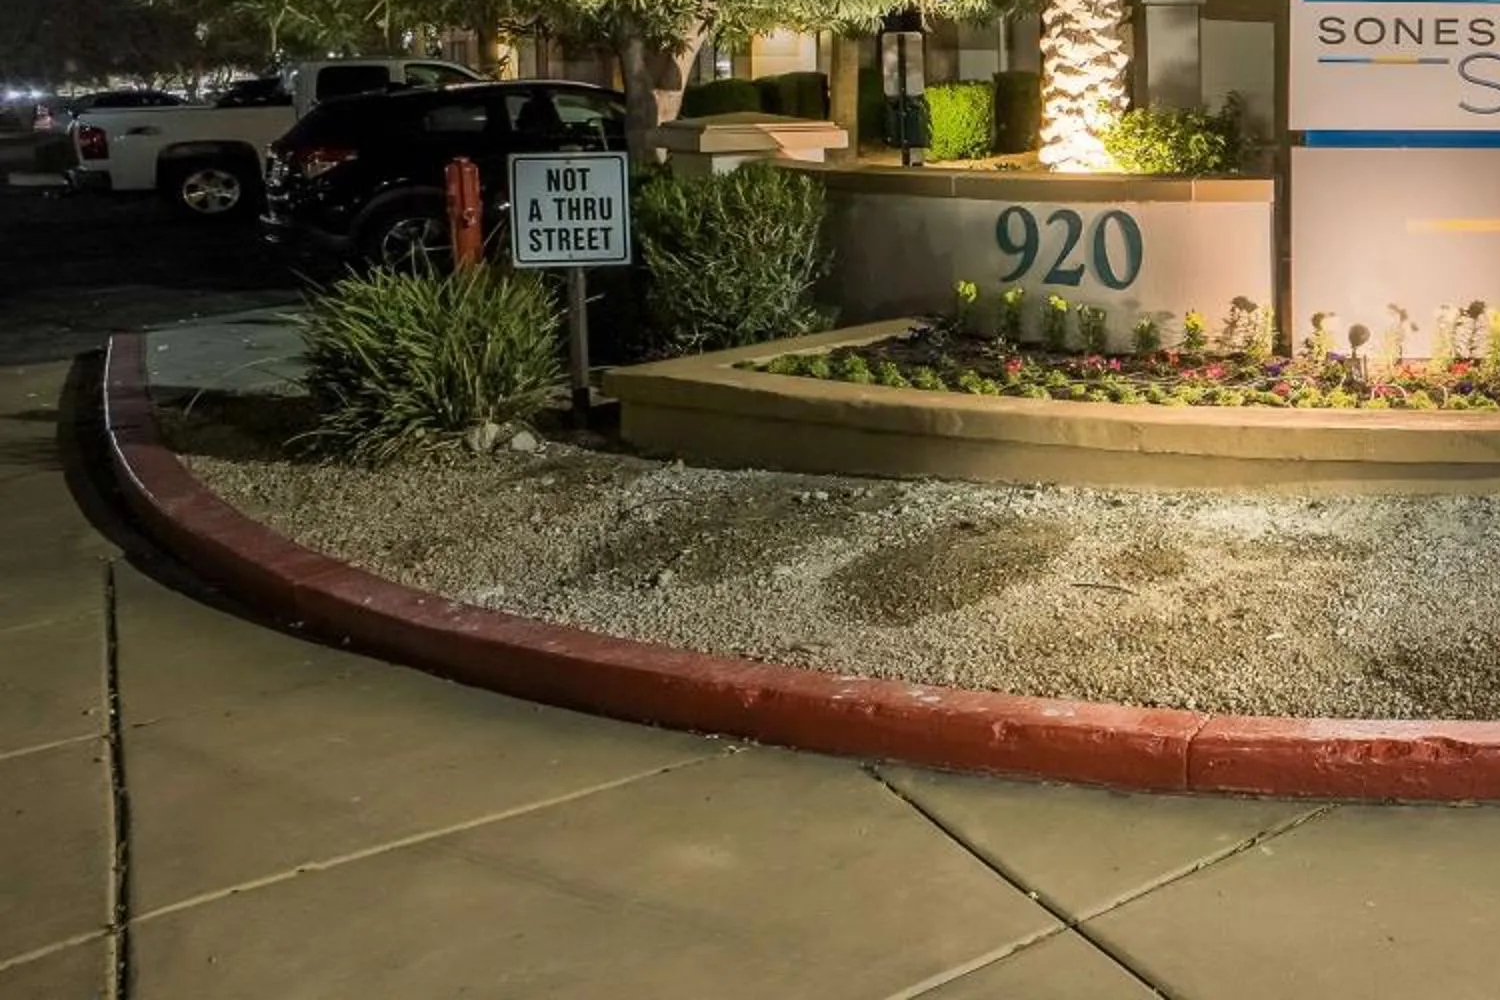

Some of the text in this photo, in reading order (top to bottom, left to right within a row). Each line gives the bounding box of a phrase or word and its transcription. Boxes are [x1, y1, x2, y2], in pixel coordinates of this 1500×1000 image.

[546, 167, 591, 192] NOT
[528, 197, 613, 222] A THRU
[528, 227, 613, 252] STREET
[994, 205, 1144, 291] 920
